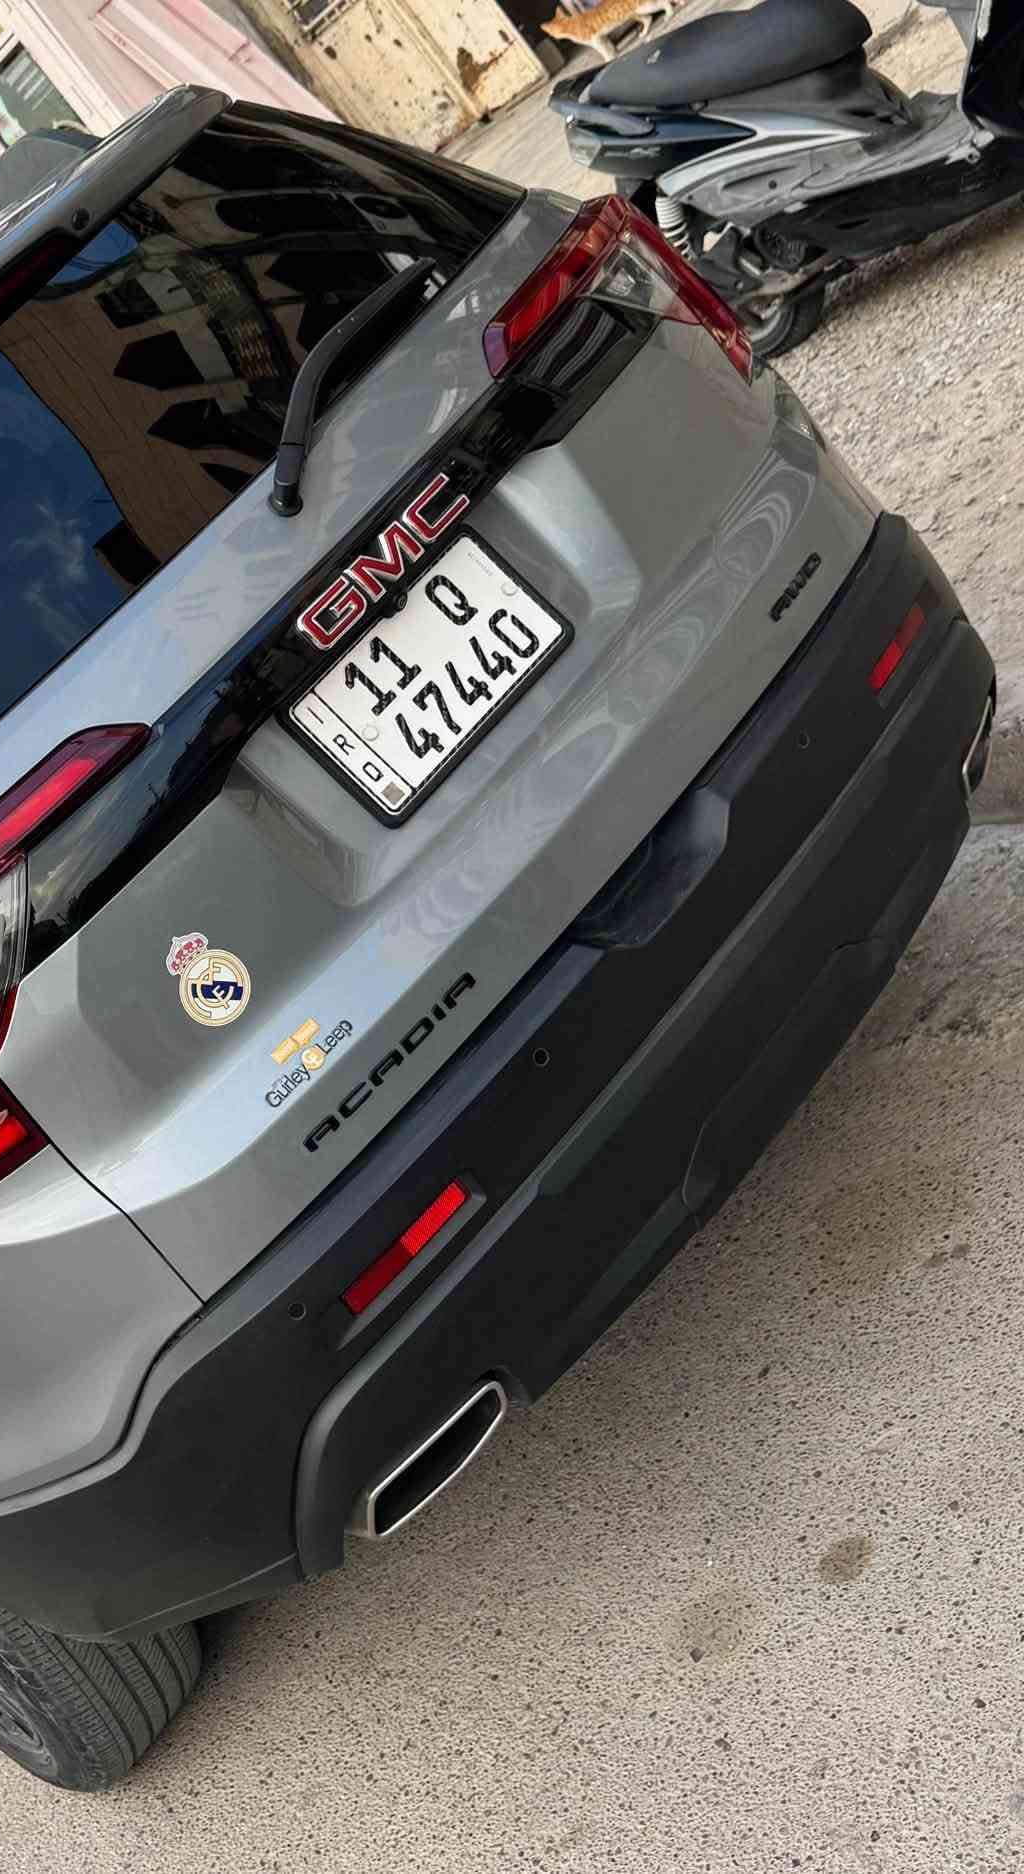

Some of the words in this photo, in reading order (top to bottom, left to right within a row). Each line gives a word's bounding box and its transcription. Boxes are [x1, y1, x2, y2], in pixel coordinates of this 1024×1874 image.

[297, 472, 470, 650] GMC
[770, 552, 822, 622] AWD
[344, 636, 422, 716] 11
[425, 574, 479, 626] Q
[394, 608, 540, 760] 47440
[265, 1064, 311, 1108] Gurley
[314, 1019, 353, 1056] Leep
[302, 972, 476, 1152] ACADIA
